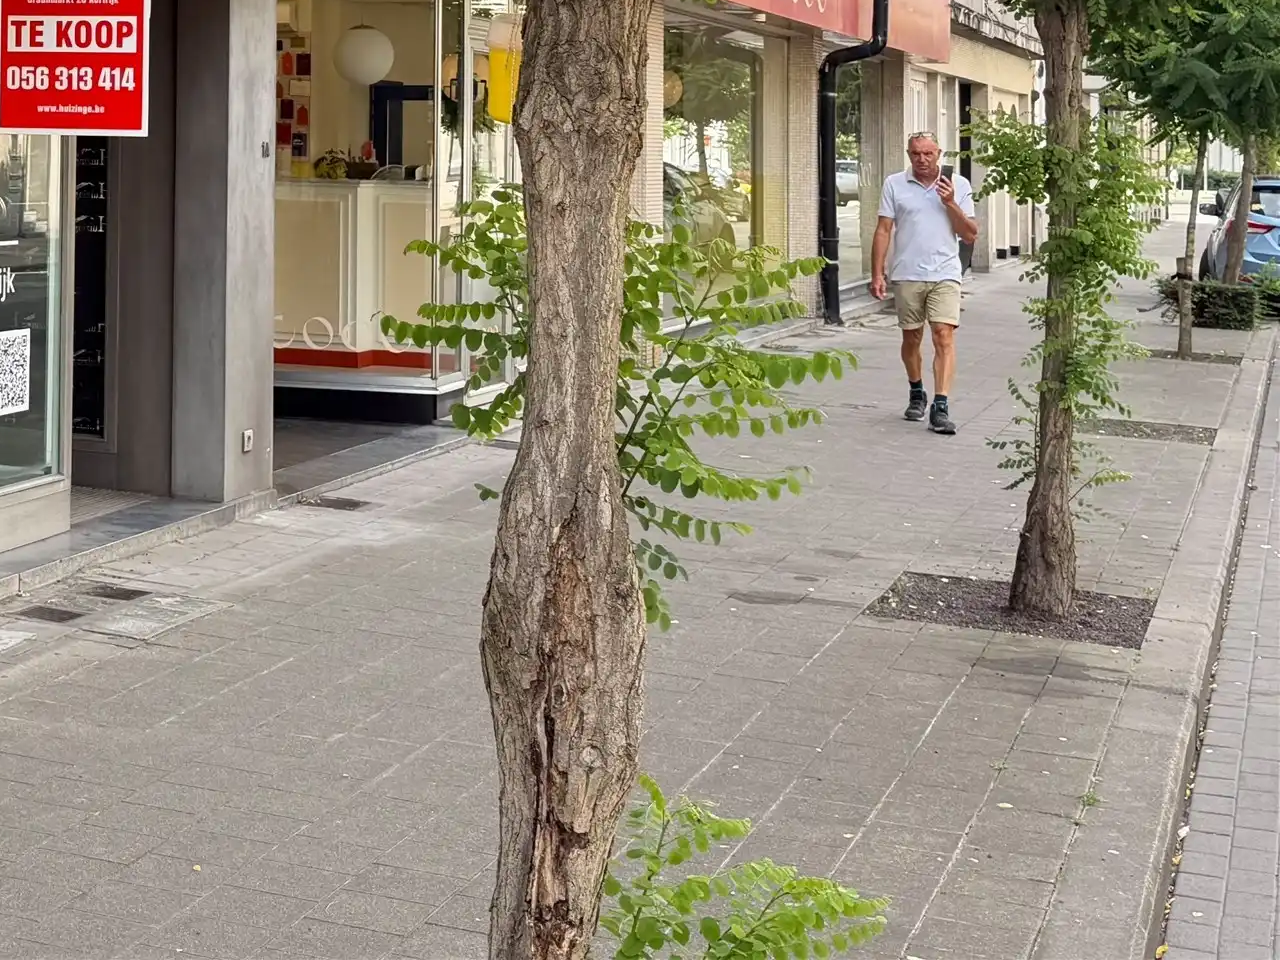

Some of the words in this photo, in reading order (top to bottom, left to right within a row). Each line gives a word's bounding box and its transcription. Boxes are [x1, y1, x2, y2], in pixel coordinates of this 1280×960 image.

[10, 20, 45, 48] TE
[55, 20, 134, 49] KOOP
[6, 65, 50, 90] 056
[54, 66, 94, 91] 313
[97, 66, 136, 92] 414
[37, 103, 105, 115] www.huizinge.be
